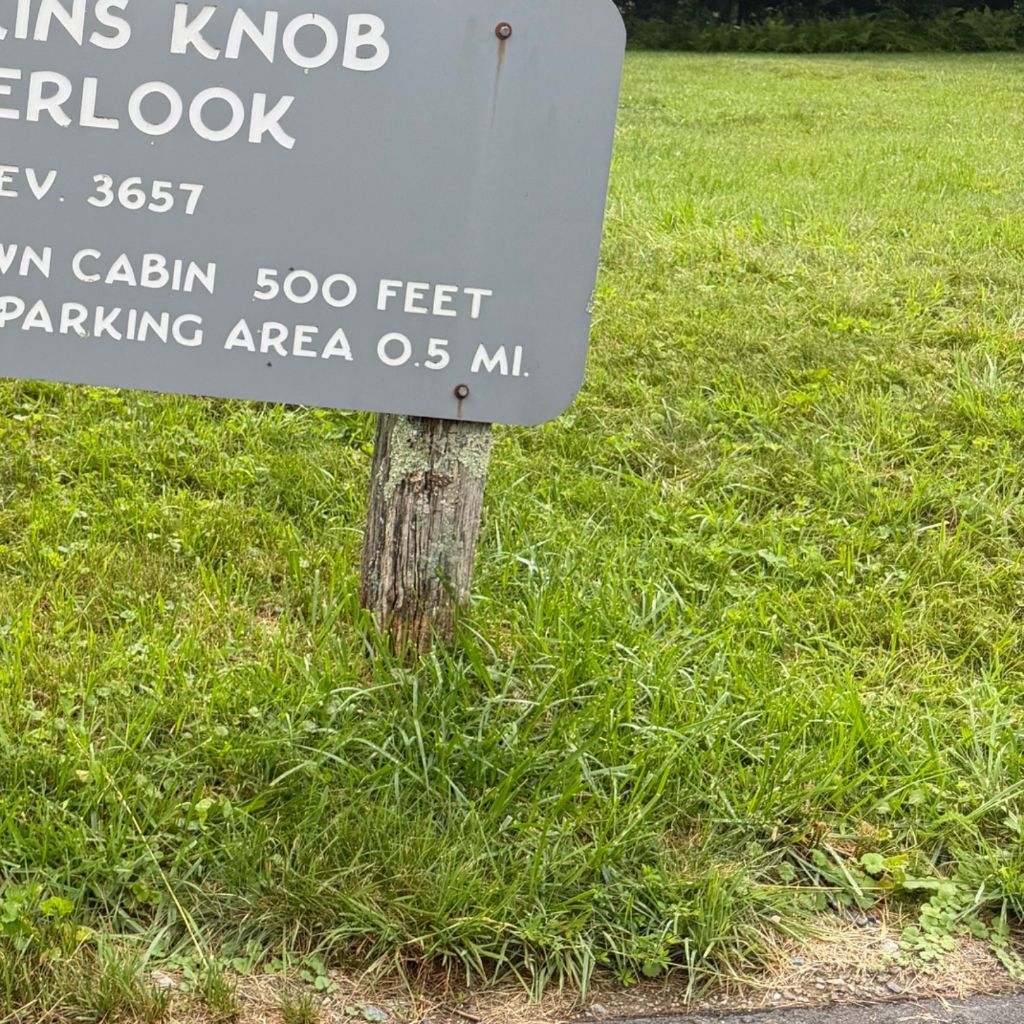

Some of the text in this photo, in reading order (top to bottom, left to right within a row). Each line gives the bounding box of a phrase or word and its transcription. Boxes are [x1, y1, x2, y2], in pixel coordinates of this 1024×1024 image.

[170, 3, 390, 72] KNOB
[87, 174, 204, 215] 3657
[71, 248, 216, 294] CABIN
[253, 268, 357, 308] 500
[376, 279, 493, 319] FEET
[223, 318, 354, 361] AREA
[377, 332, 450, 370] 0.5
[470, 343, 529, 377] MI.
